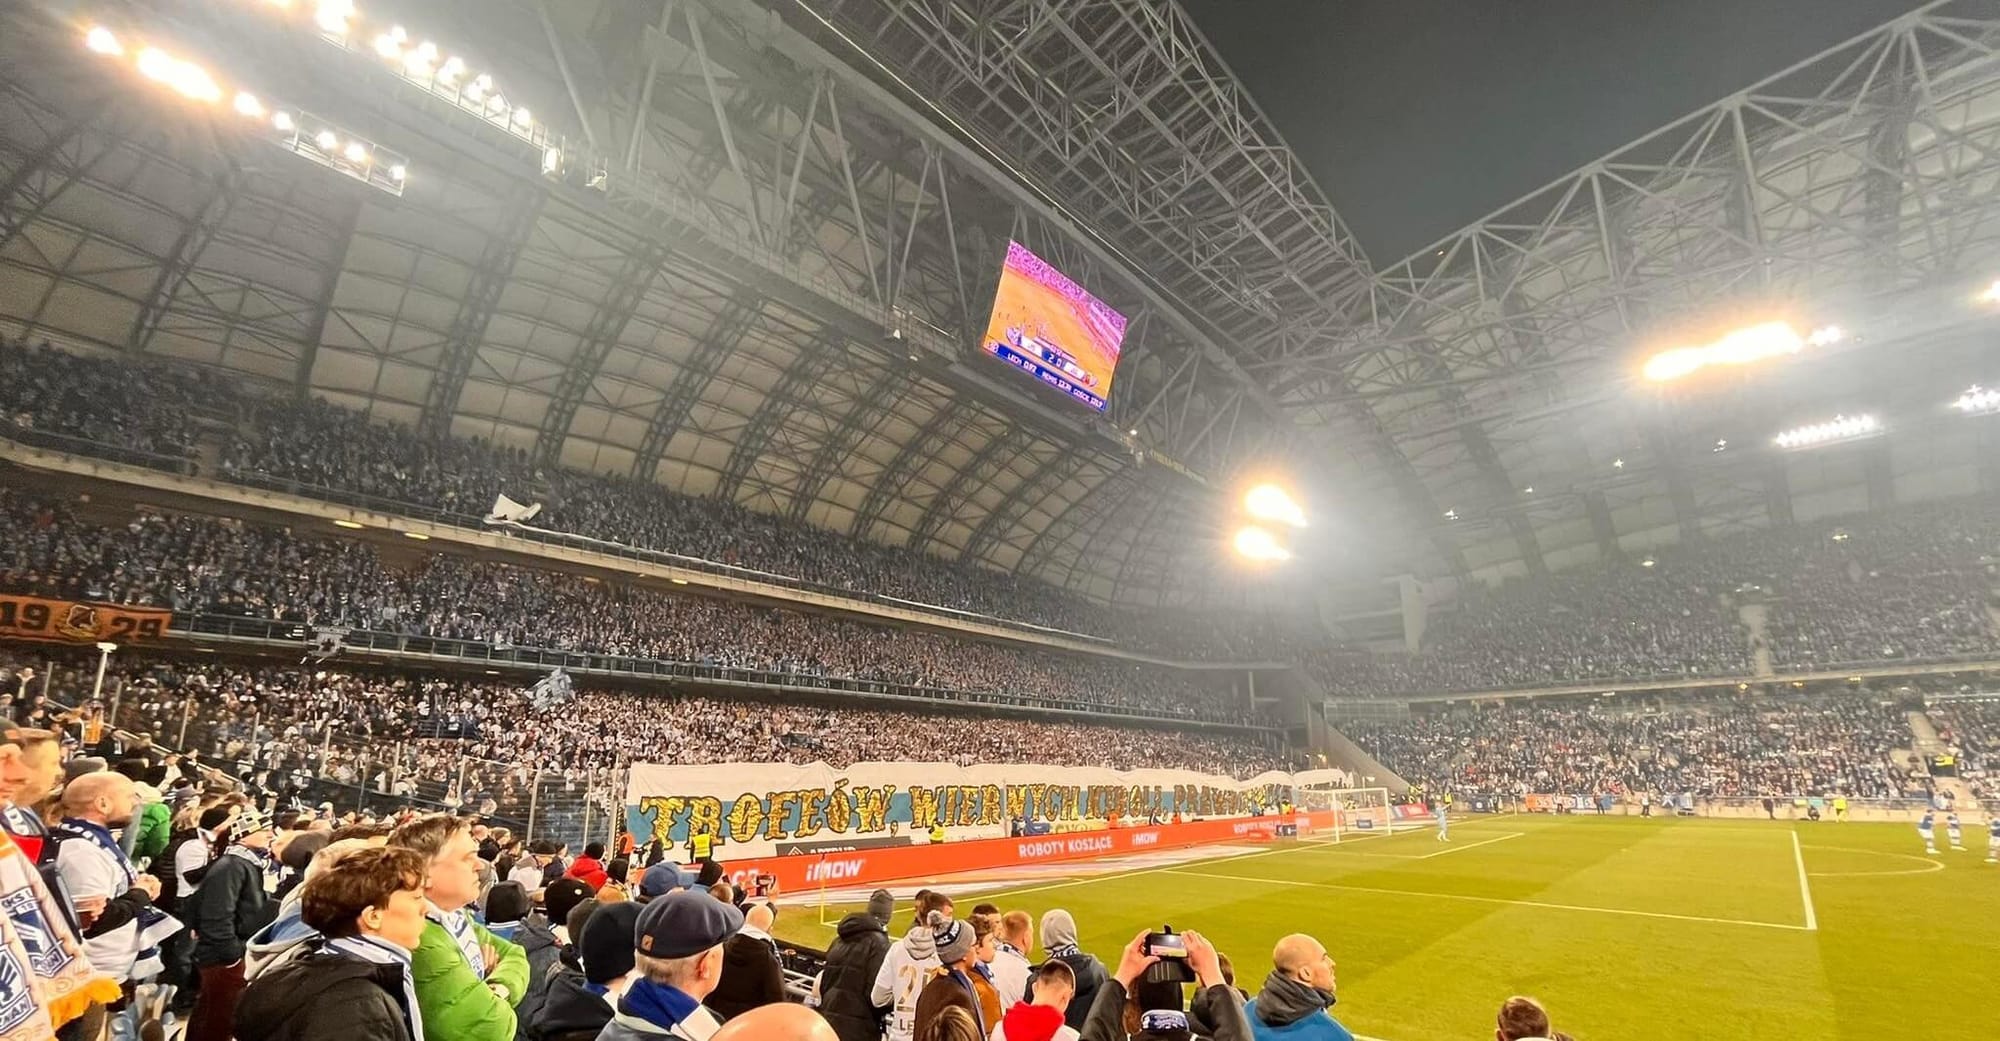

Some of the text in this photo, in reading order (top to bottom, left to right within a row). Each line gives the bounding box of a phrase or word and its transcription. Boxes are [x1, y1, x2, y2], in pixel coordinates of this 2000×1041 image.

[0, 601, 162, 641] 19 29
[640, 778, 898, 850] TROFEÓW,
[909, 783, 1081, 829] WIERNYCH
[1018, 836, 1113, 858] ROBOTY KOSZĄCE
